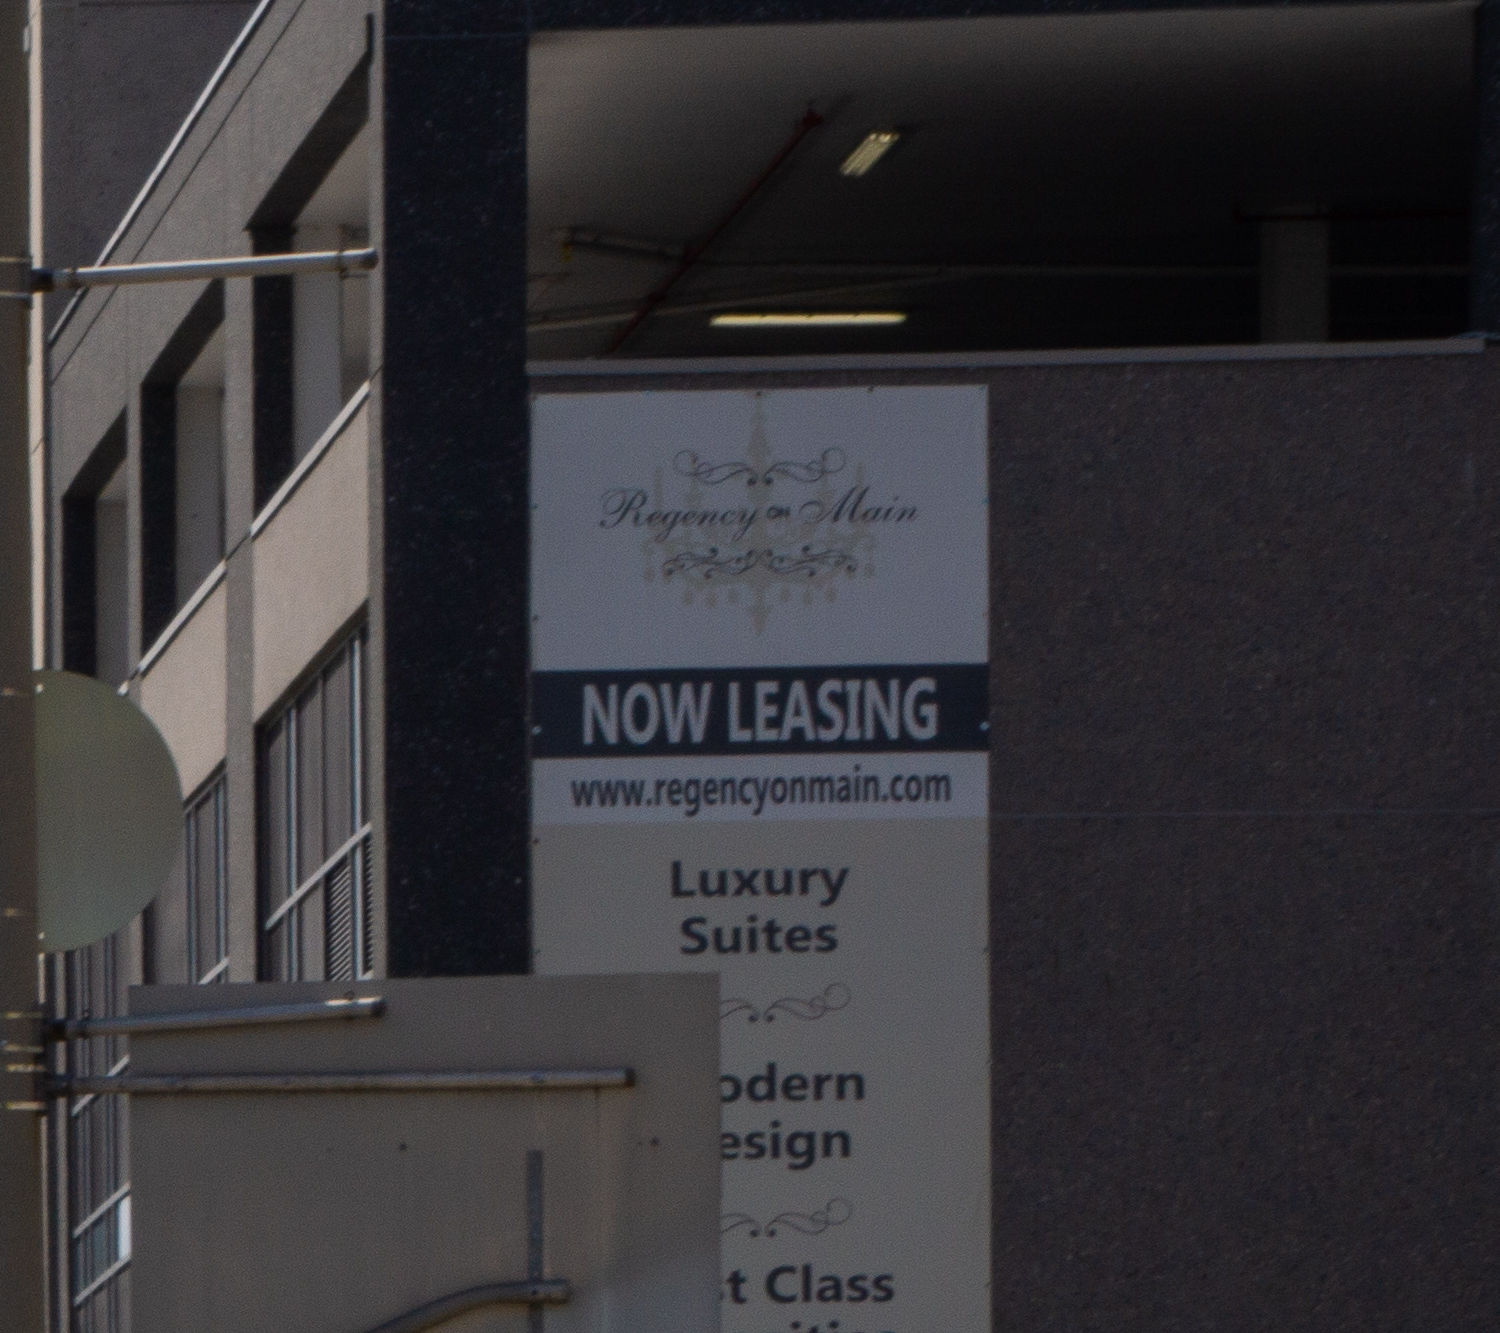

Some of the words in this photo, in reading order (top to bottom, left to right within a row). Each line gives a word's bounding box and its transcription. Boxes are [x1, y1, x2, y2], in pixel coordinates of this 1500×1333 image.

[599, 487, 759, 542] Regency
[799, 485, 918, 526] Main
[583, 682, 713, 745] NOW
[727, 677, 938, 742] LEASING
[570, 765, 953, 817] www.regencyonmain.com
[670, 860, 850, 906] Luxury
[680, 914, 840, 955] Suites
[719, 1062, 867, 1102] odern
[719, 1122, 852, 1170] esign
[765, 1263, 896, 1304] Class
